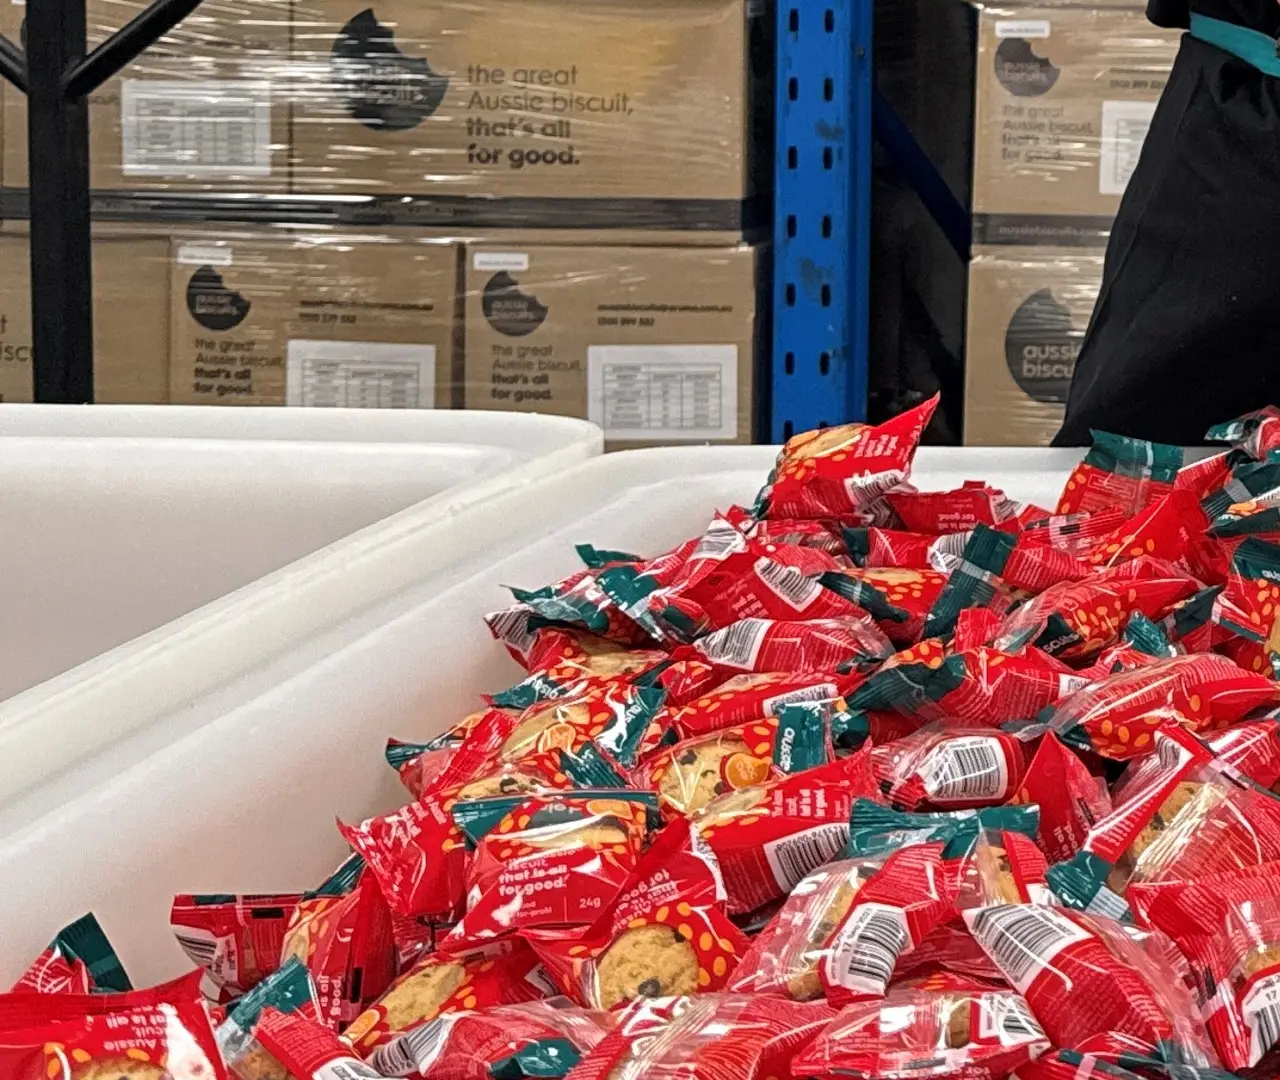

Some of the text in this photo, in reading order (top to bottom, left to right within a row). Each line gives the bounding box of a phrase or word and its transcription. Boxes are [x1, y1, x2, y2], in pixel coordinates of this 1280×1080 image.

[468, 64, 578, 88] the great
[467, 91, 634, 116] Aussie biscuit,
[466, 117, 571, 138] that's all
[467, 143, 580, 169] for good.
[1022, 358, 1076, 378] biscu
[499, 869, 530, 884] that
[499, 883, 522, 897] for
[1265, 991, 1279, 1001] 17
